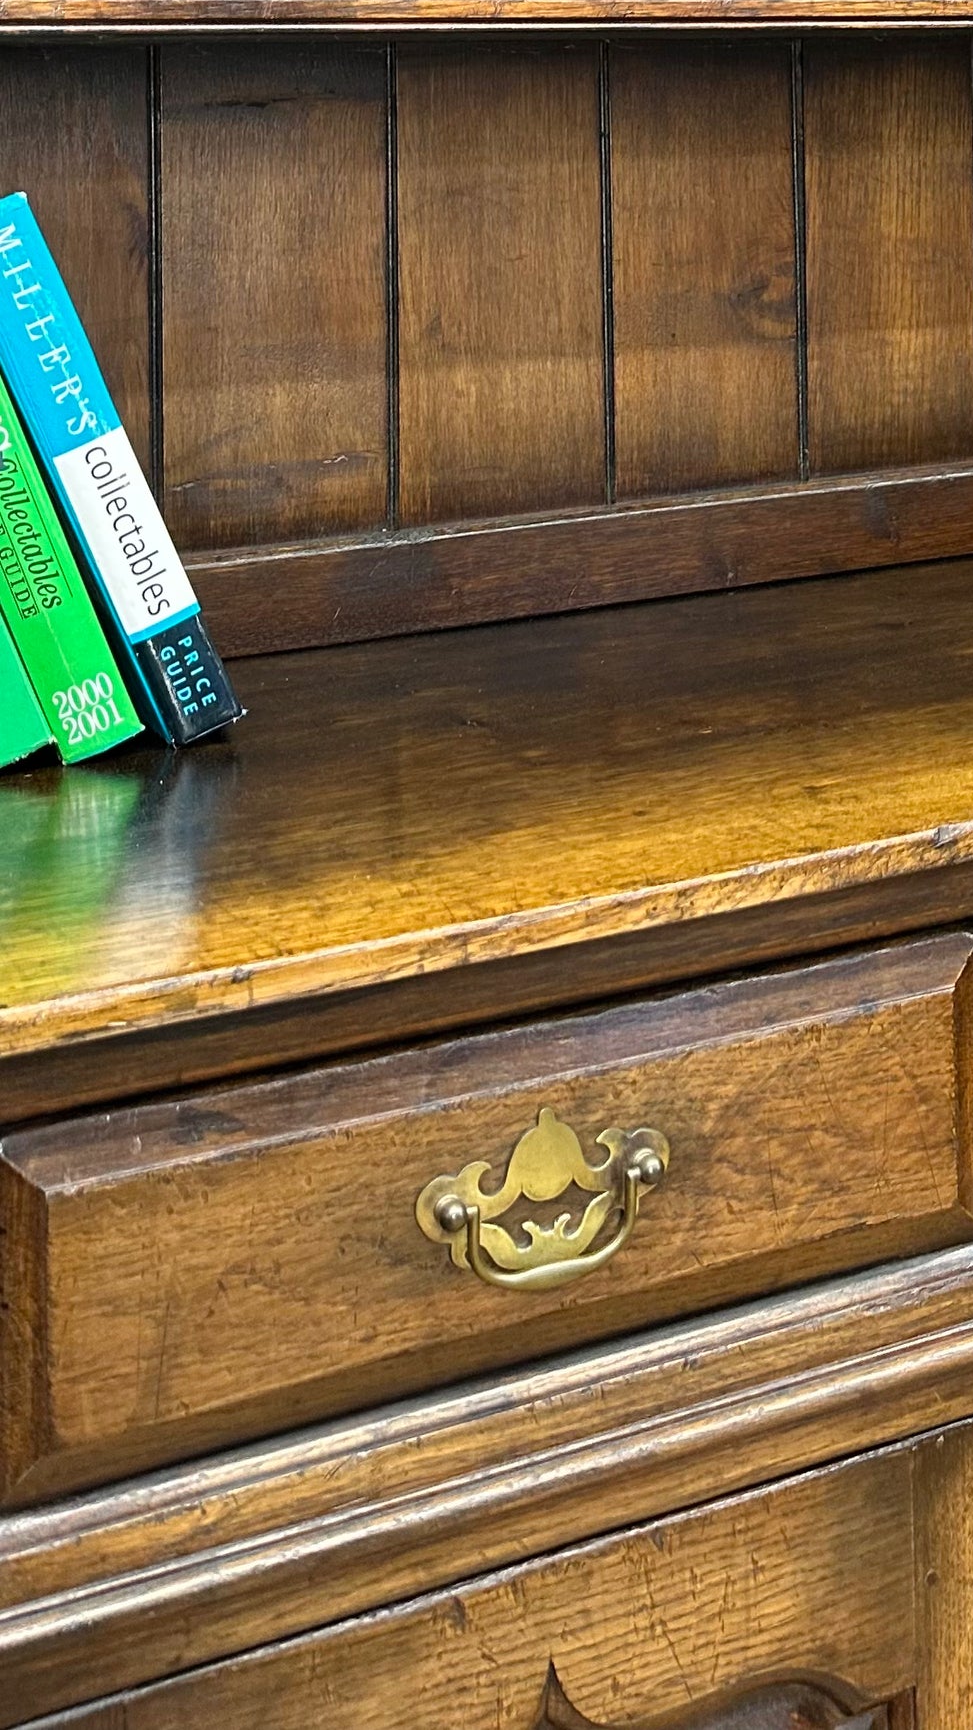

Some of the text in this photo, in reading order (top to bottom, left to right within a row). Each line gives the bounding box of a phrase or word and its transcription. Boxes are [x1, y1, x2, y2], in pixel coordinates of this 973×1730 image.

[85, 446, 170, 615] collectables
[0, 547, 38, 619] GUIDE
[52, 672, 113, 719] 2000
[160, 646, 198, 716] GUIDE
[178, 635, 216, 707] PRICE
[62, 701, 124, 745] 2001
